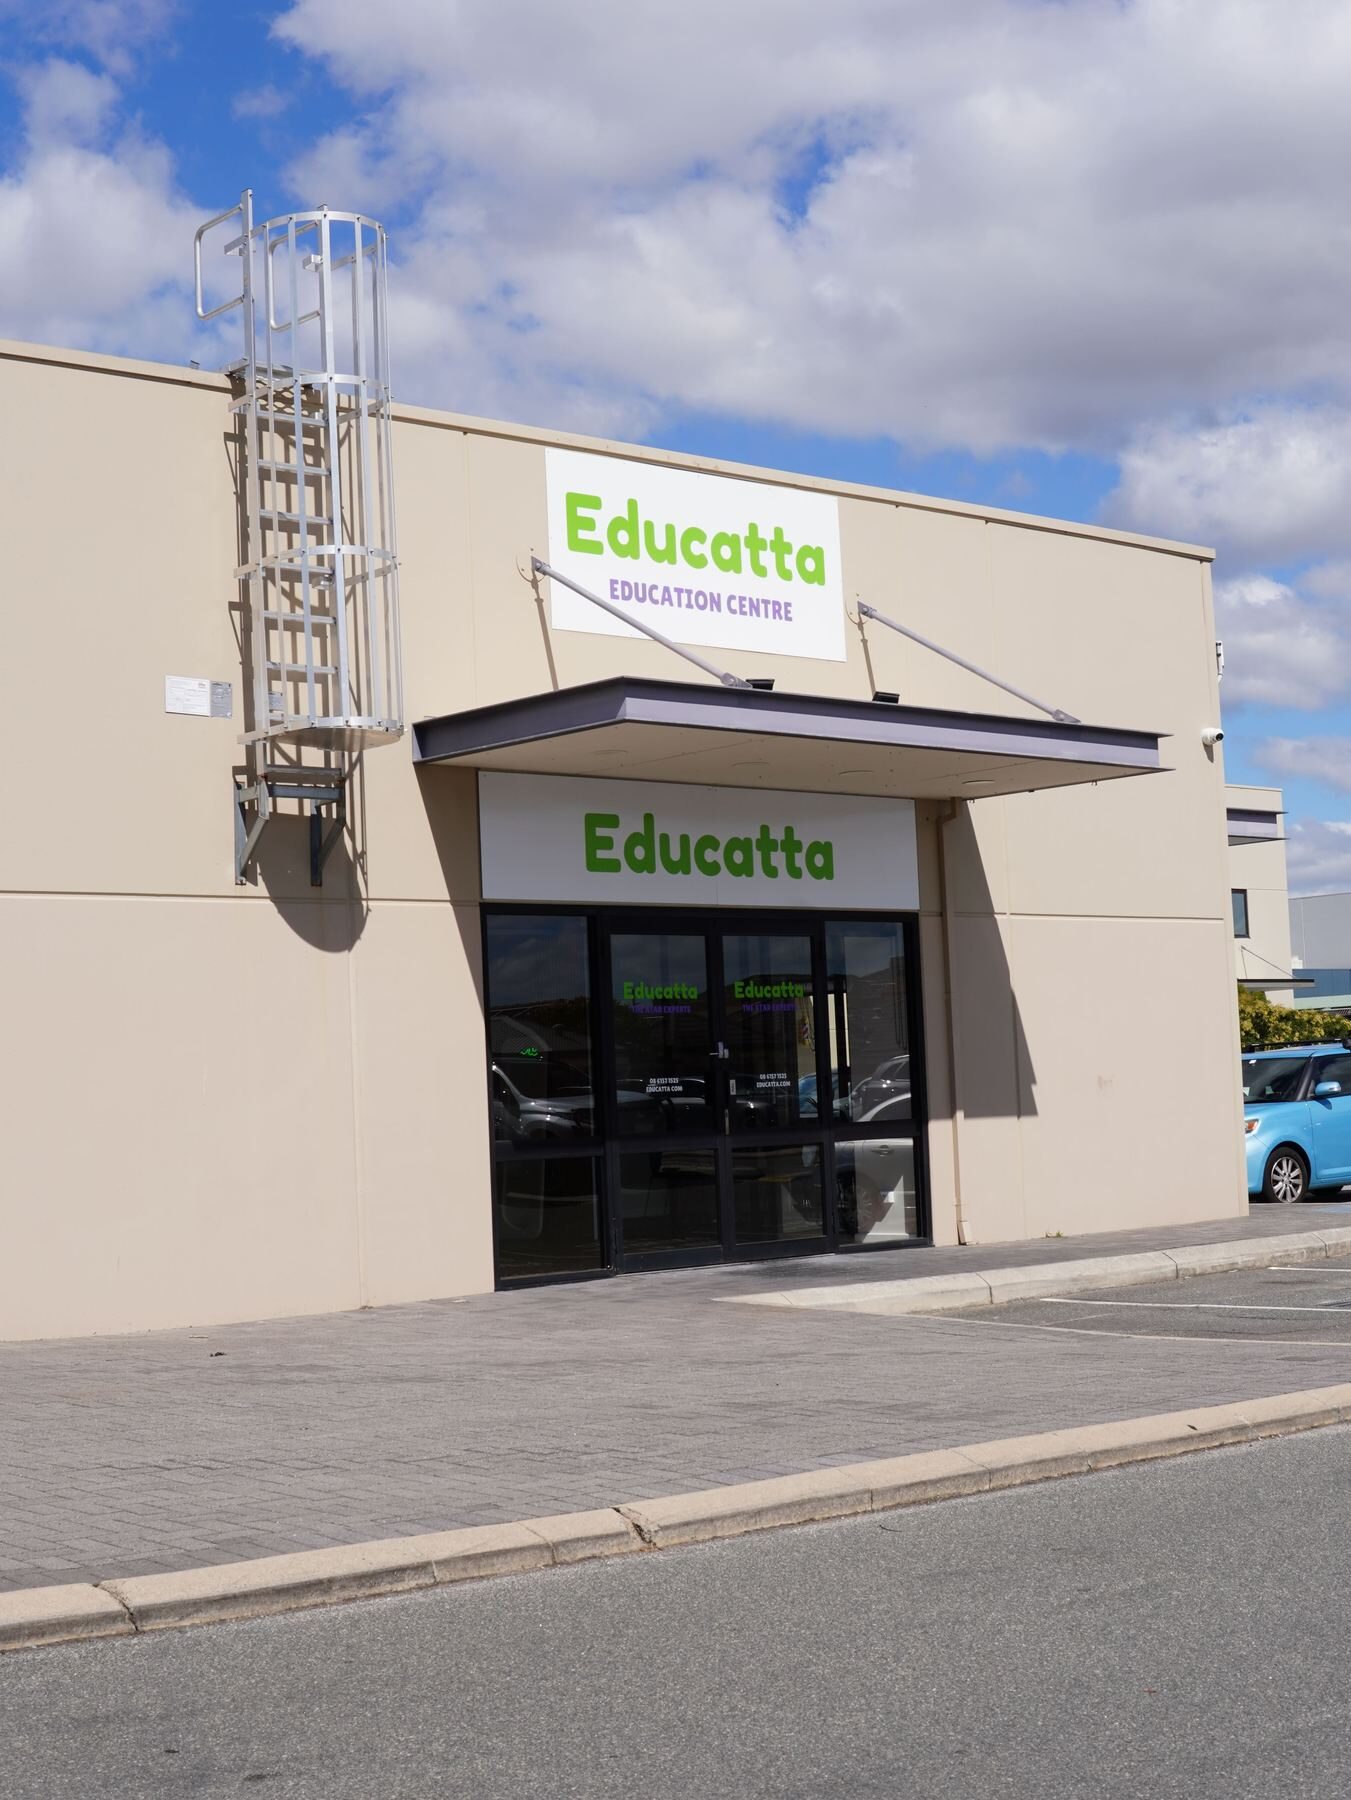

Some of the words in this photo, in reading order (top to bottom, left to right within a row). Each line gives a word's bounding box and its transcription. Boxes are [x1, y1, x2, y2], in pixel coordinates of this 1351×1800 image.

[565, 491, 826, 586] Educatta
[608, 578, 722, 613] EDUCATION
[726, 594, 793, 622] CENTRE
[584, 812, 834, 881] Educatta
[623, 980, 698, 1000] Educatta
[734, 979, 804, 999] Educatta
[756, 1080, 791, 1088] EDUCATTA.COM
